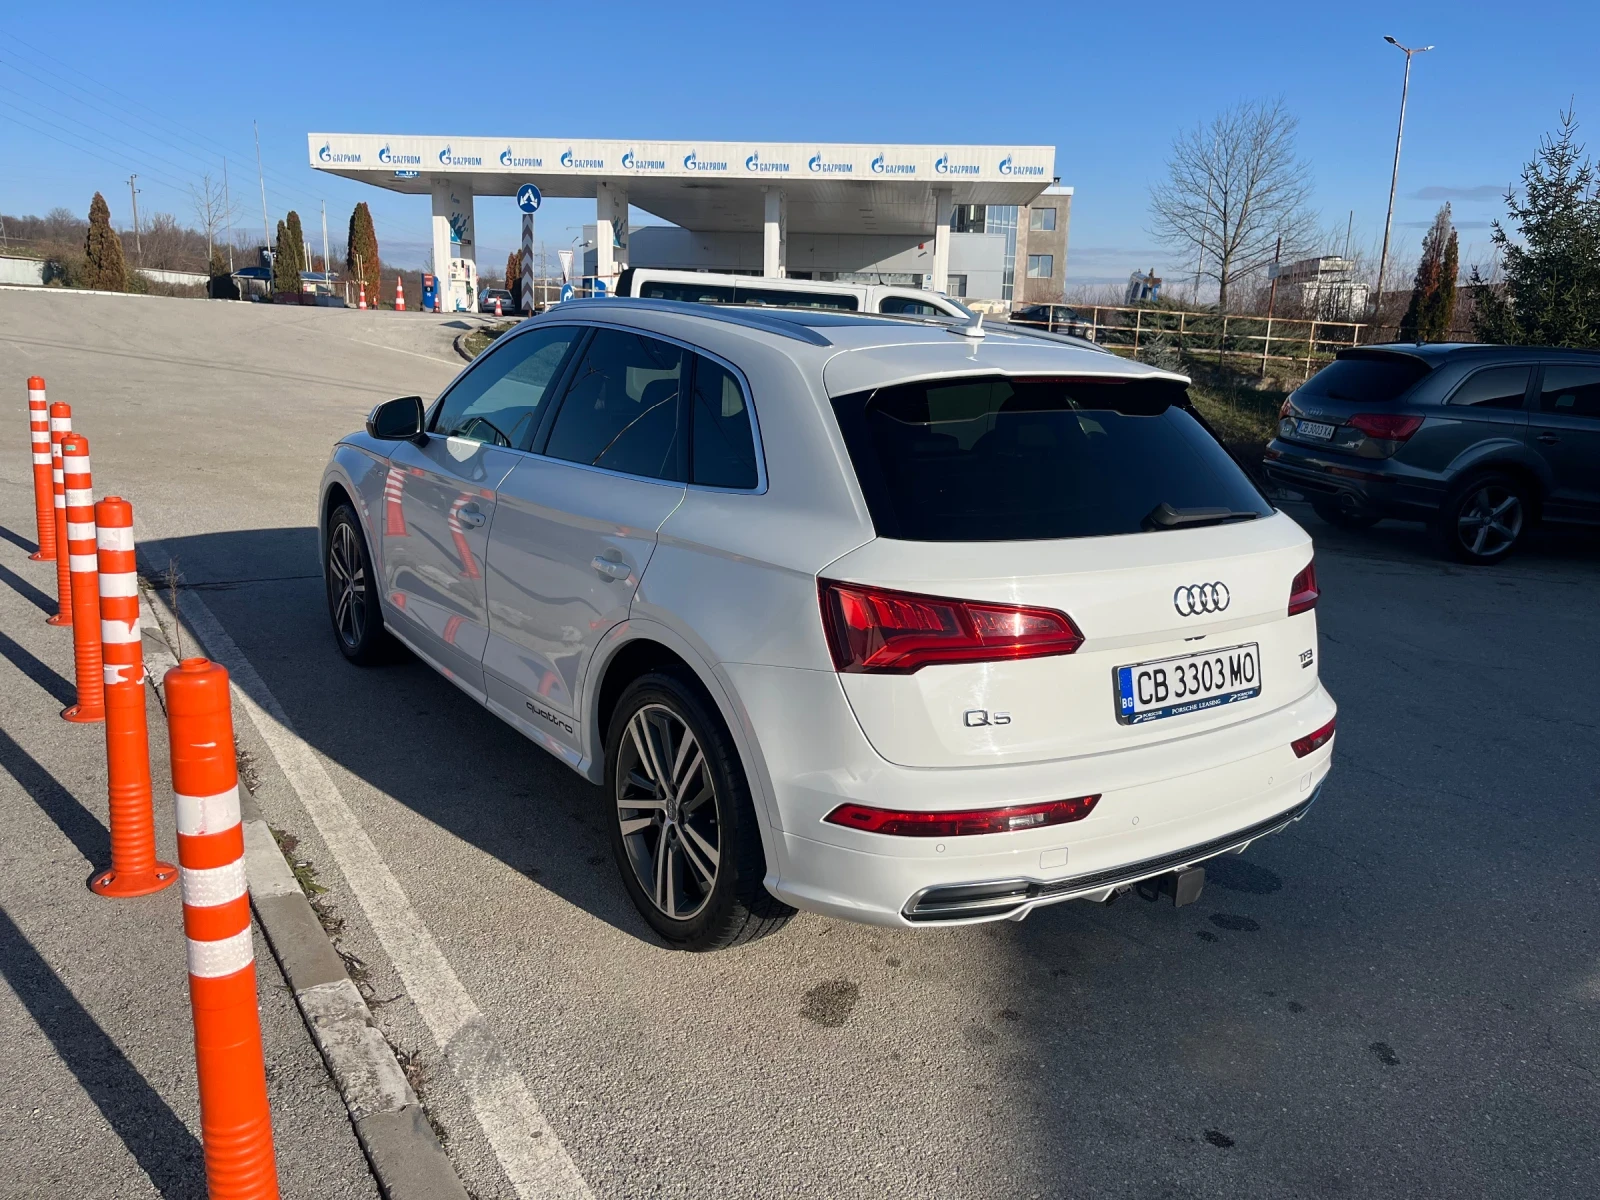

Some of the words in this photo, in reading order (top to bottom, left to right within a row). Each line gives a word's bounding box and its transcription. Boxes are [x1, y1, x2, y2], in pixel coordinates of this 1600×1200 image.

[452, 157, 482, 166] GAZPROM
[513, 158, 543, 167] GAZPROM
[574, 160, 604, 168] GAZPROM
[635, 160, 665, 169] GAZPROM
[697, 161, 727, 170] GAZPROM
[759, 162, 790, 171] GAZPROM
[822, 163, 852, 172] GAZPROM
[885, 164, 916, 173] GAZPROM
[949, 165, 980, 174] GAZPROM
[1013, 166, 1044, 175] GAZPROM
[1137, 668, 1169, 705] CB
[1174, 657, 1226, 698] 3303
[1228, 652, 1255, 687] MO
[1122, 697, 1133, 708] BG
[1171, 704, 1198, 715] PORSCHE
[1198, 698, 1222, 710] LEASING
[525, 702, 573, 734] quattro
[963, 709, 1011, 727] Q5
